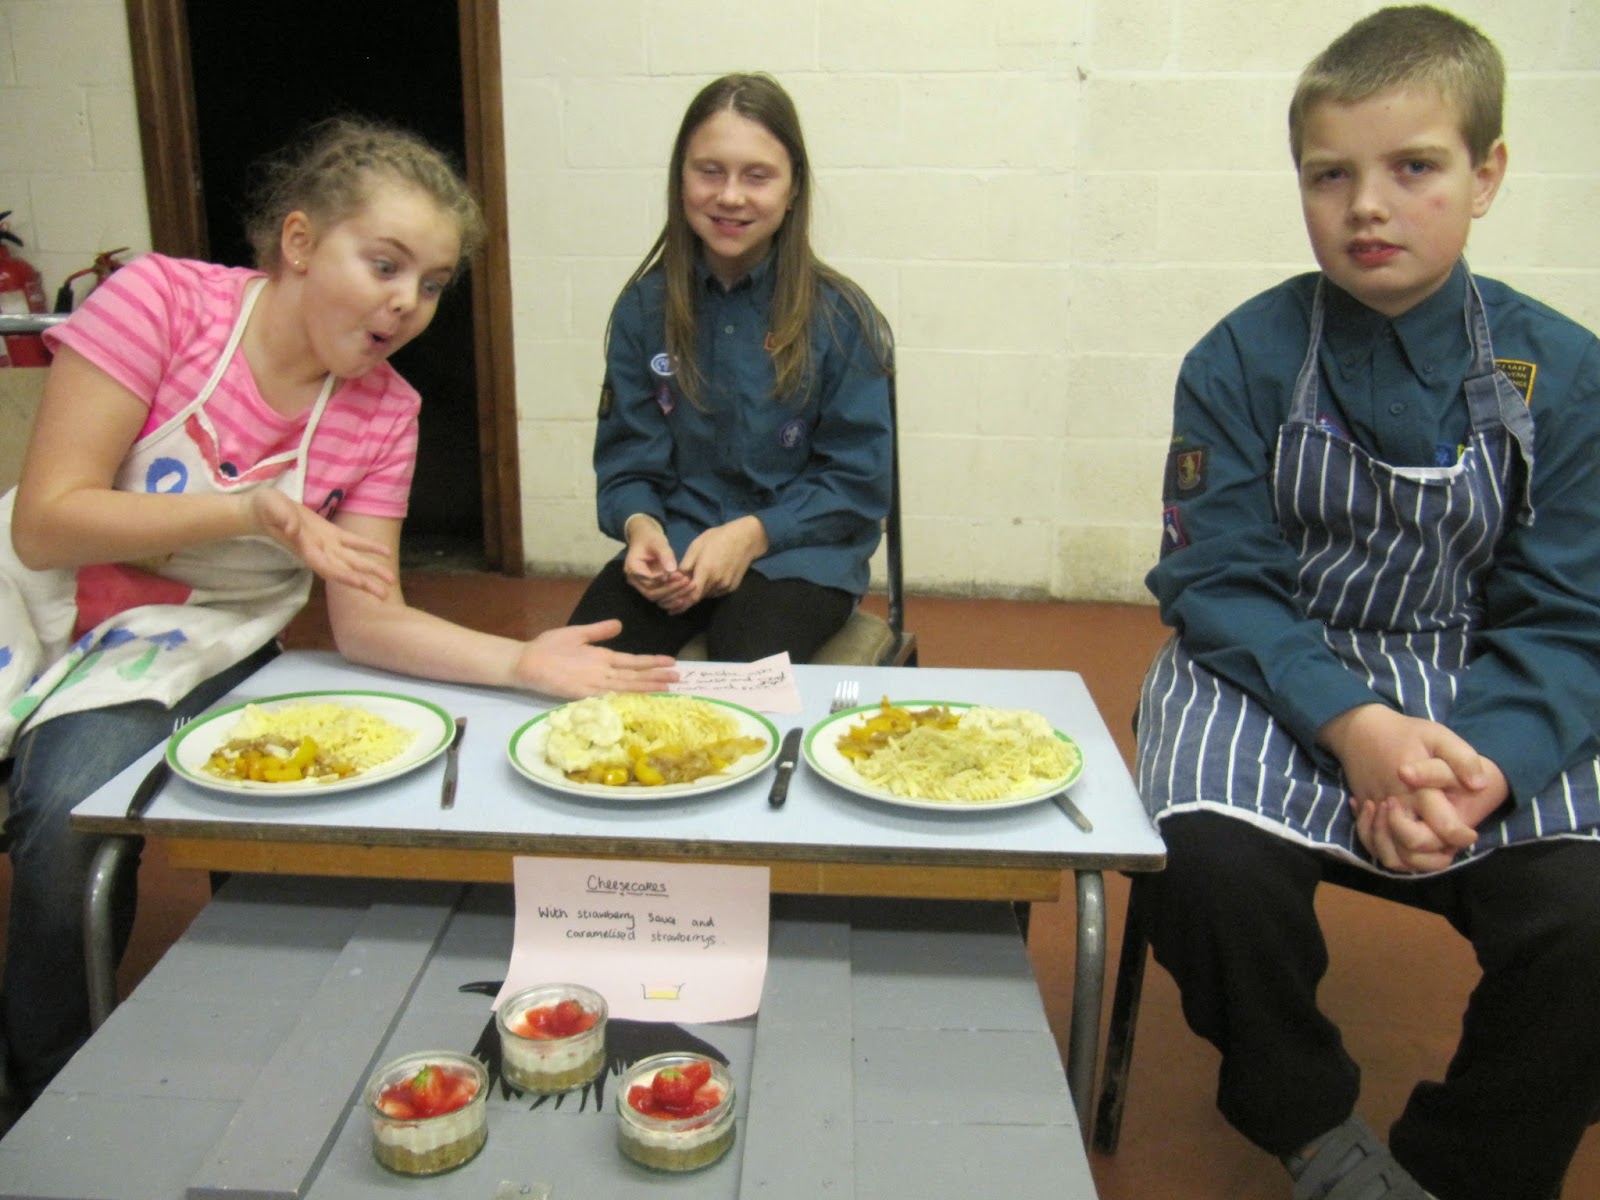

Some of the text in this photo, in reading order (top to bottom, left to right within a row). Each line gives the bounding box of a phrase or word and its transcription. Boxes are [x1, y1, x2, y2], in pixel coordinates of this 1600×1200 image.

[586, 874, 668, 892] Cheesecakes
[538, 906, 569, 919] With
[577, 909, 635, 930] strawberry
[691, 916, 715, 928] and
[566, 929, 636, 941] caramelised
